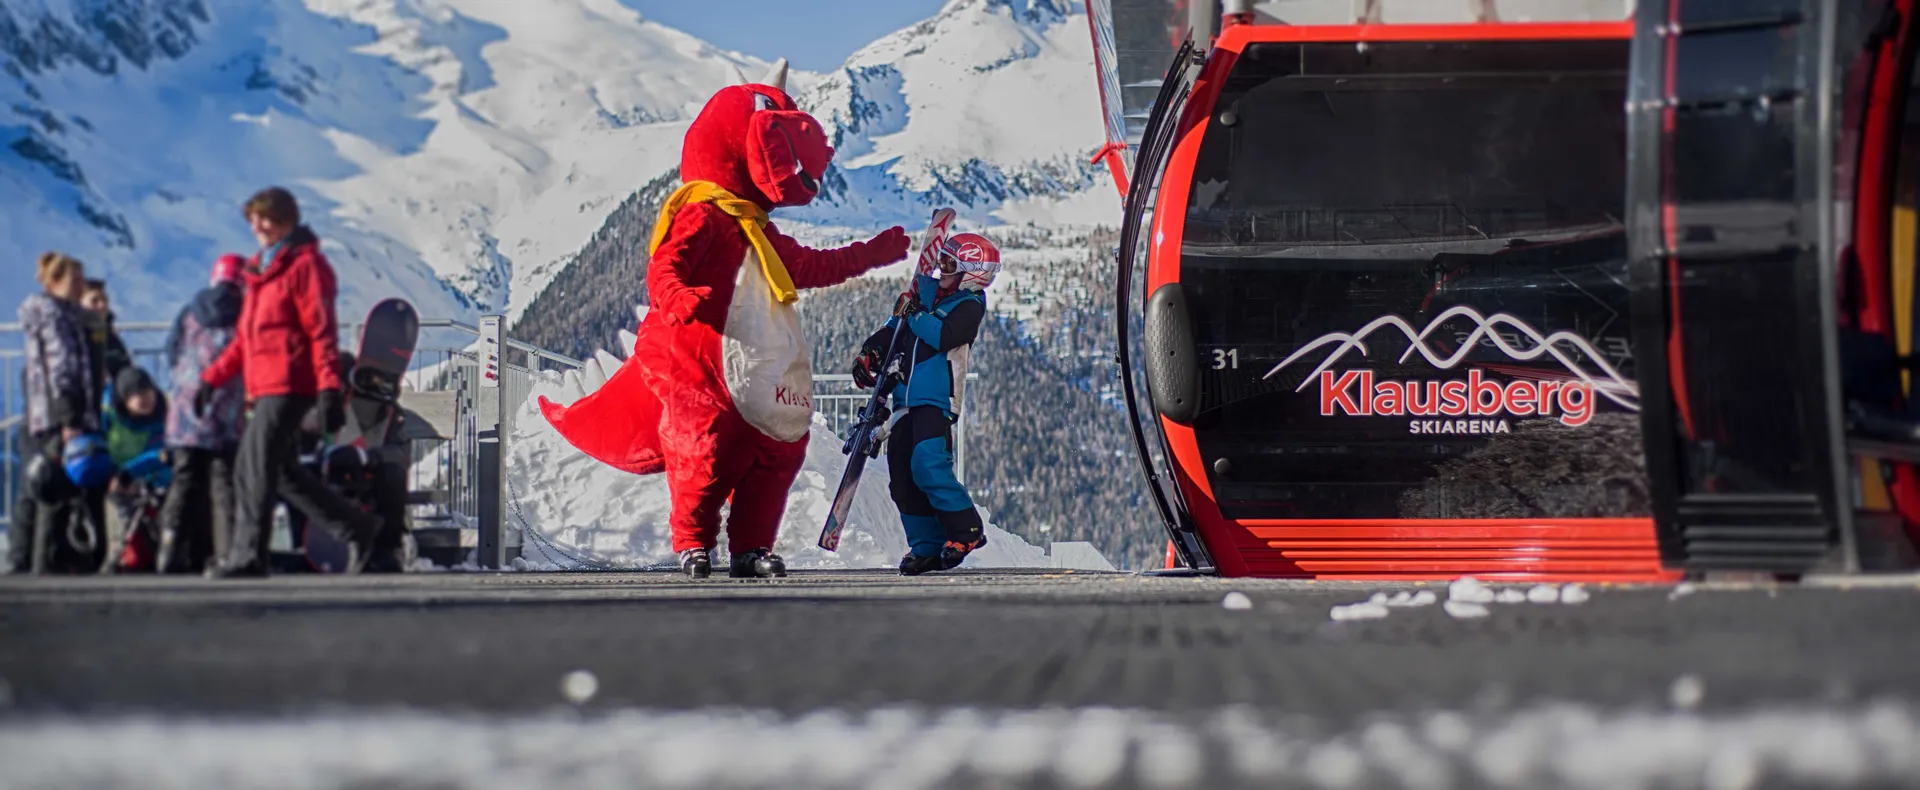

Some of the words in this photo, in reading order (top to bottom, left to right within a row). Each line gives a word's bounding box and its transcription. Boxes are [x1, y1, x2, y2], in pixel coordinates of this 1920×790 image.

[1211, 348, 1238, 370] 31
[1320, 369, 1595, 426] Klausberg
[1409, 420, 1509, 434] SKIARENA
